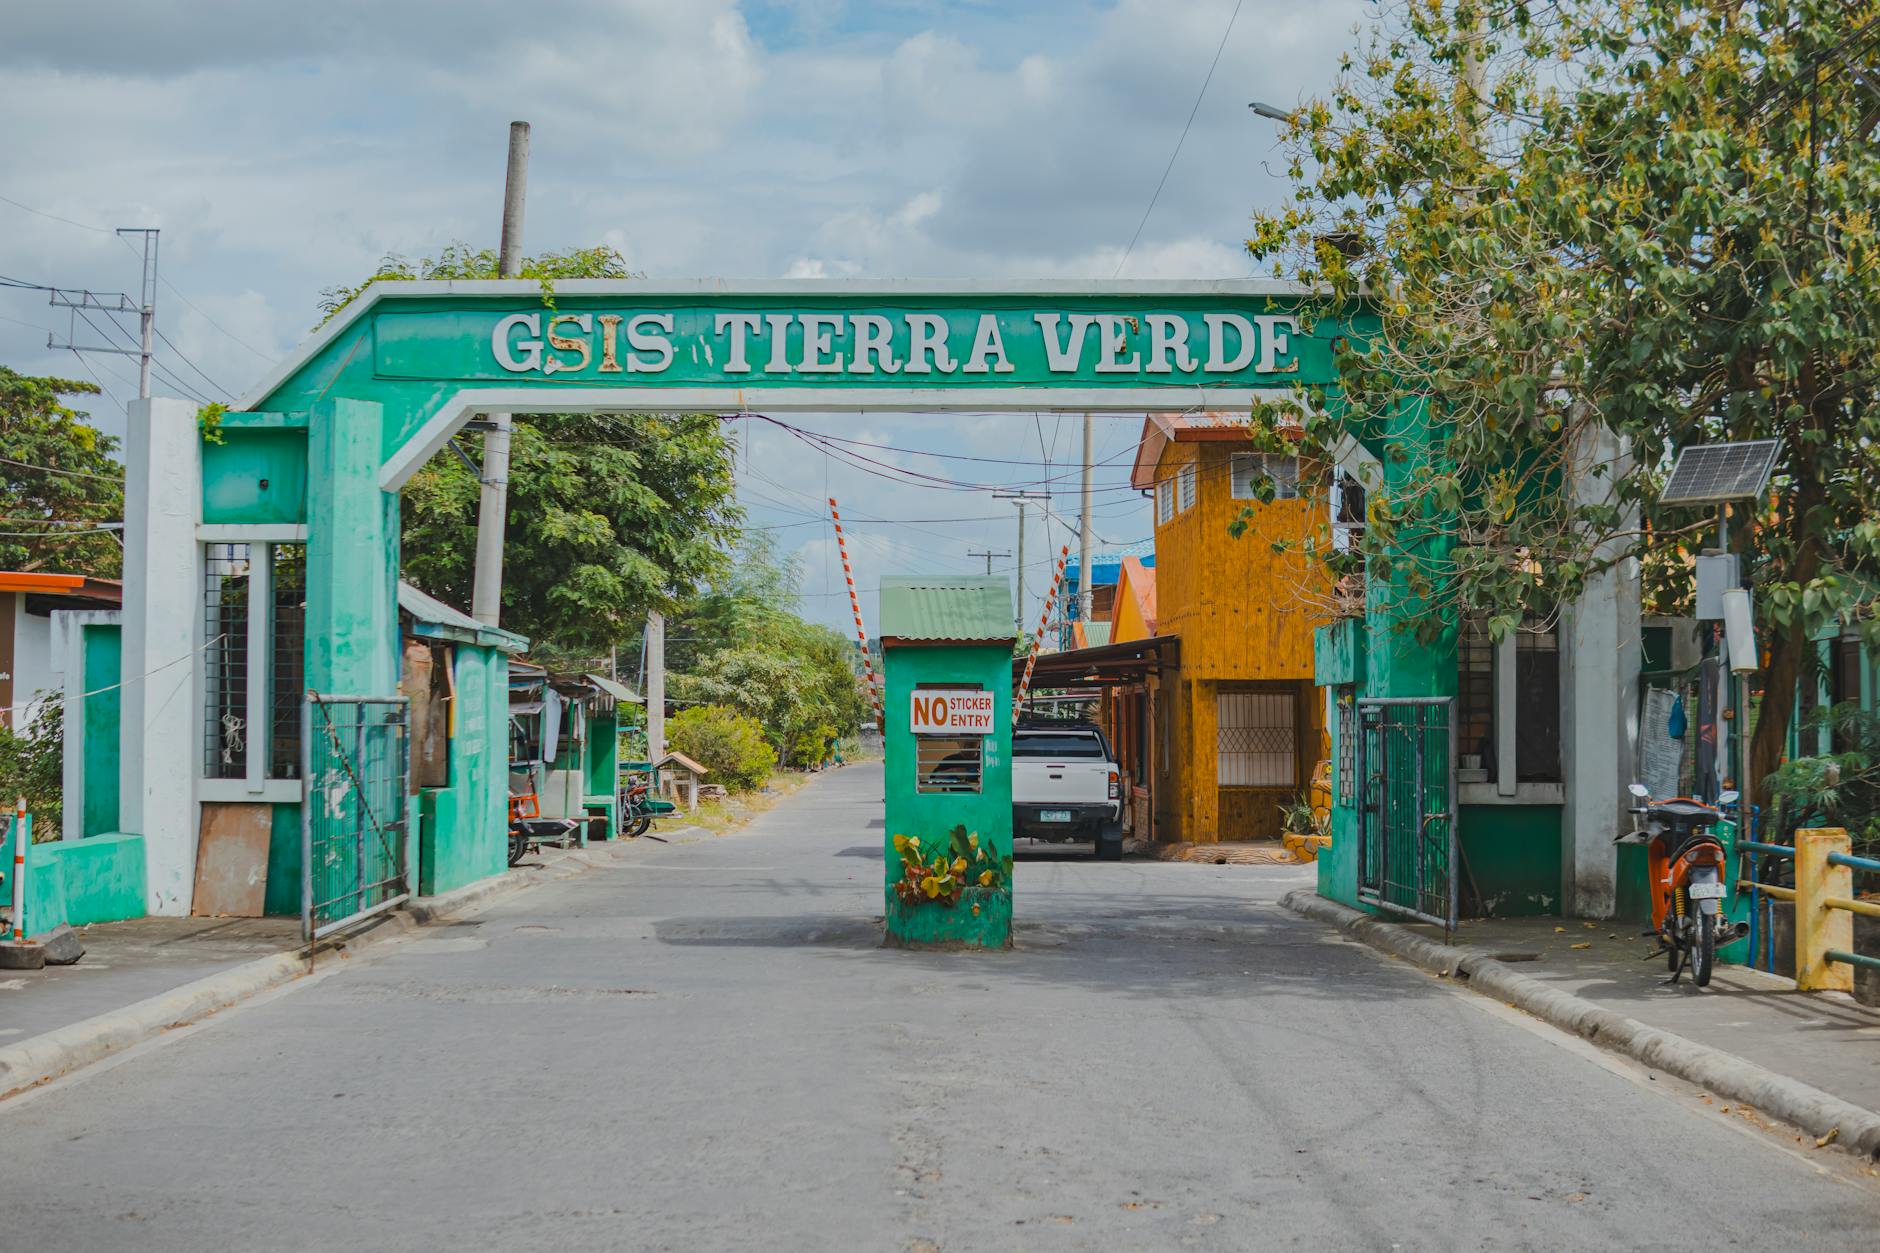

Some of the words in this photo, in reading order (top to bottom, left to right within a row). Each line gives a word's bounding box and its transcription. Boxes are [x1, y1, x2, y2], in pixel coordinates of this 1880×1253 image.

[492, 313, 674, 374] GSIS
[714, 313, 1015, 373] TIERRA
[1034, 313, 1300, 373] VERDE
[914, 697, 948, 727] NO
[950, 697, 991, 710] STICKER
[950, 714, 990, 727] ENTRY
